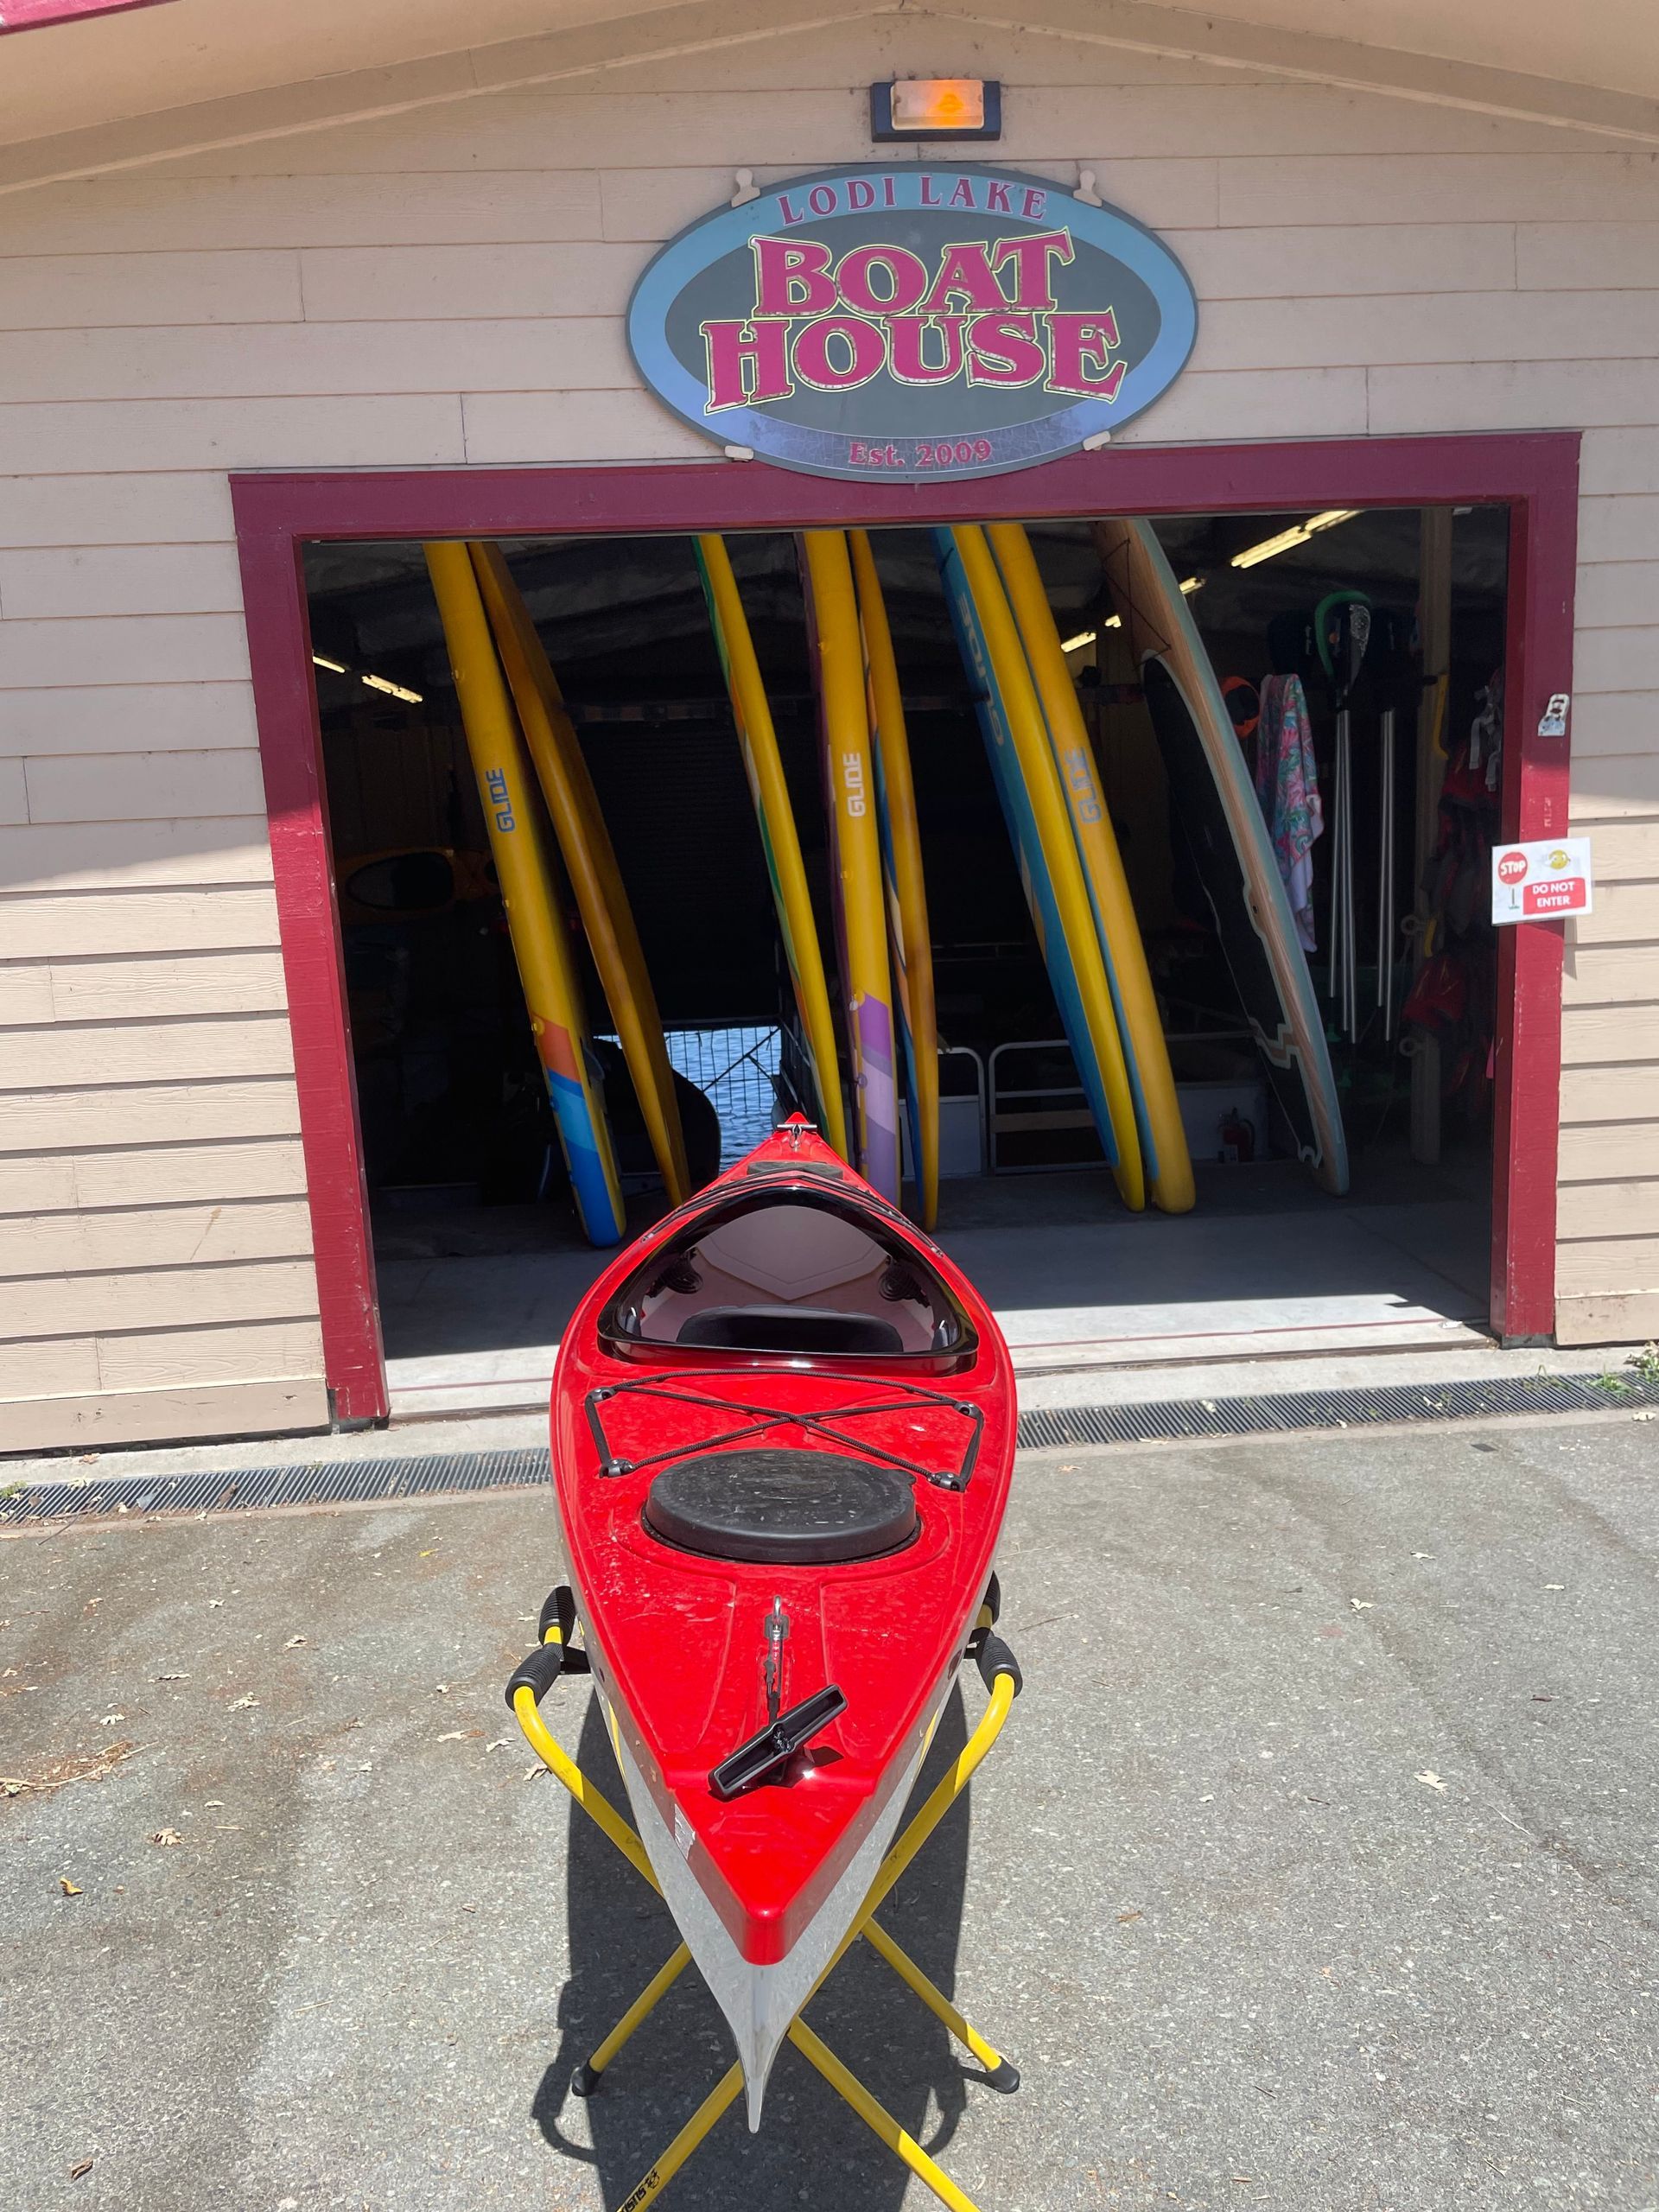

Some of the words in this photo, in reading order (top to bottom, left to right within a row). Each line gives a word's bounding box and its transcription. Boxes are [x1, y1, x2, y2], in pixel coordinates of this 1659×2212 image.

[777, 176, 895, 226] LODI
[918, 175, 1047, 220] LAKE
[749, 227, 1075, 320] BOAT
[700, 307, 1128, 416] HOUSE
[849, 442, 905, 467] Est.
[915, 439, 992, 467] 2009
[486, 767, 516, 833] GLIDE
[842, 752, 866, 817] GLIDE
[1064, 747, 1102, 824] GLIDE
[1500, 859, 1527, 876] STOP
[1532, 884, 1549, 895] DO
[1550, 881, 1575, 893] NOT
[1536, 895, 1571, 908] ENTER
